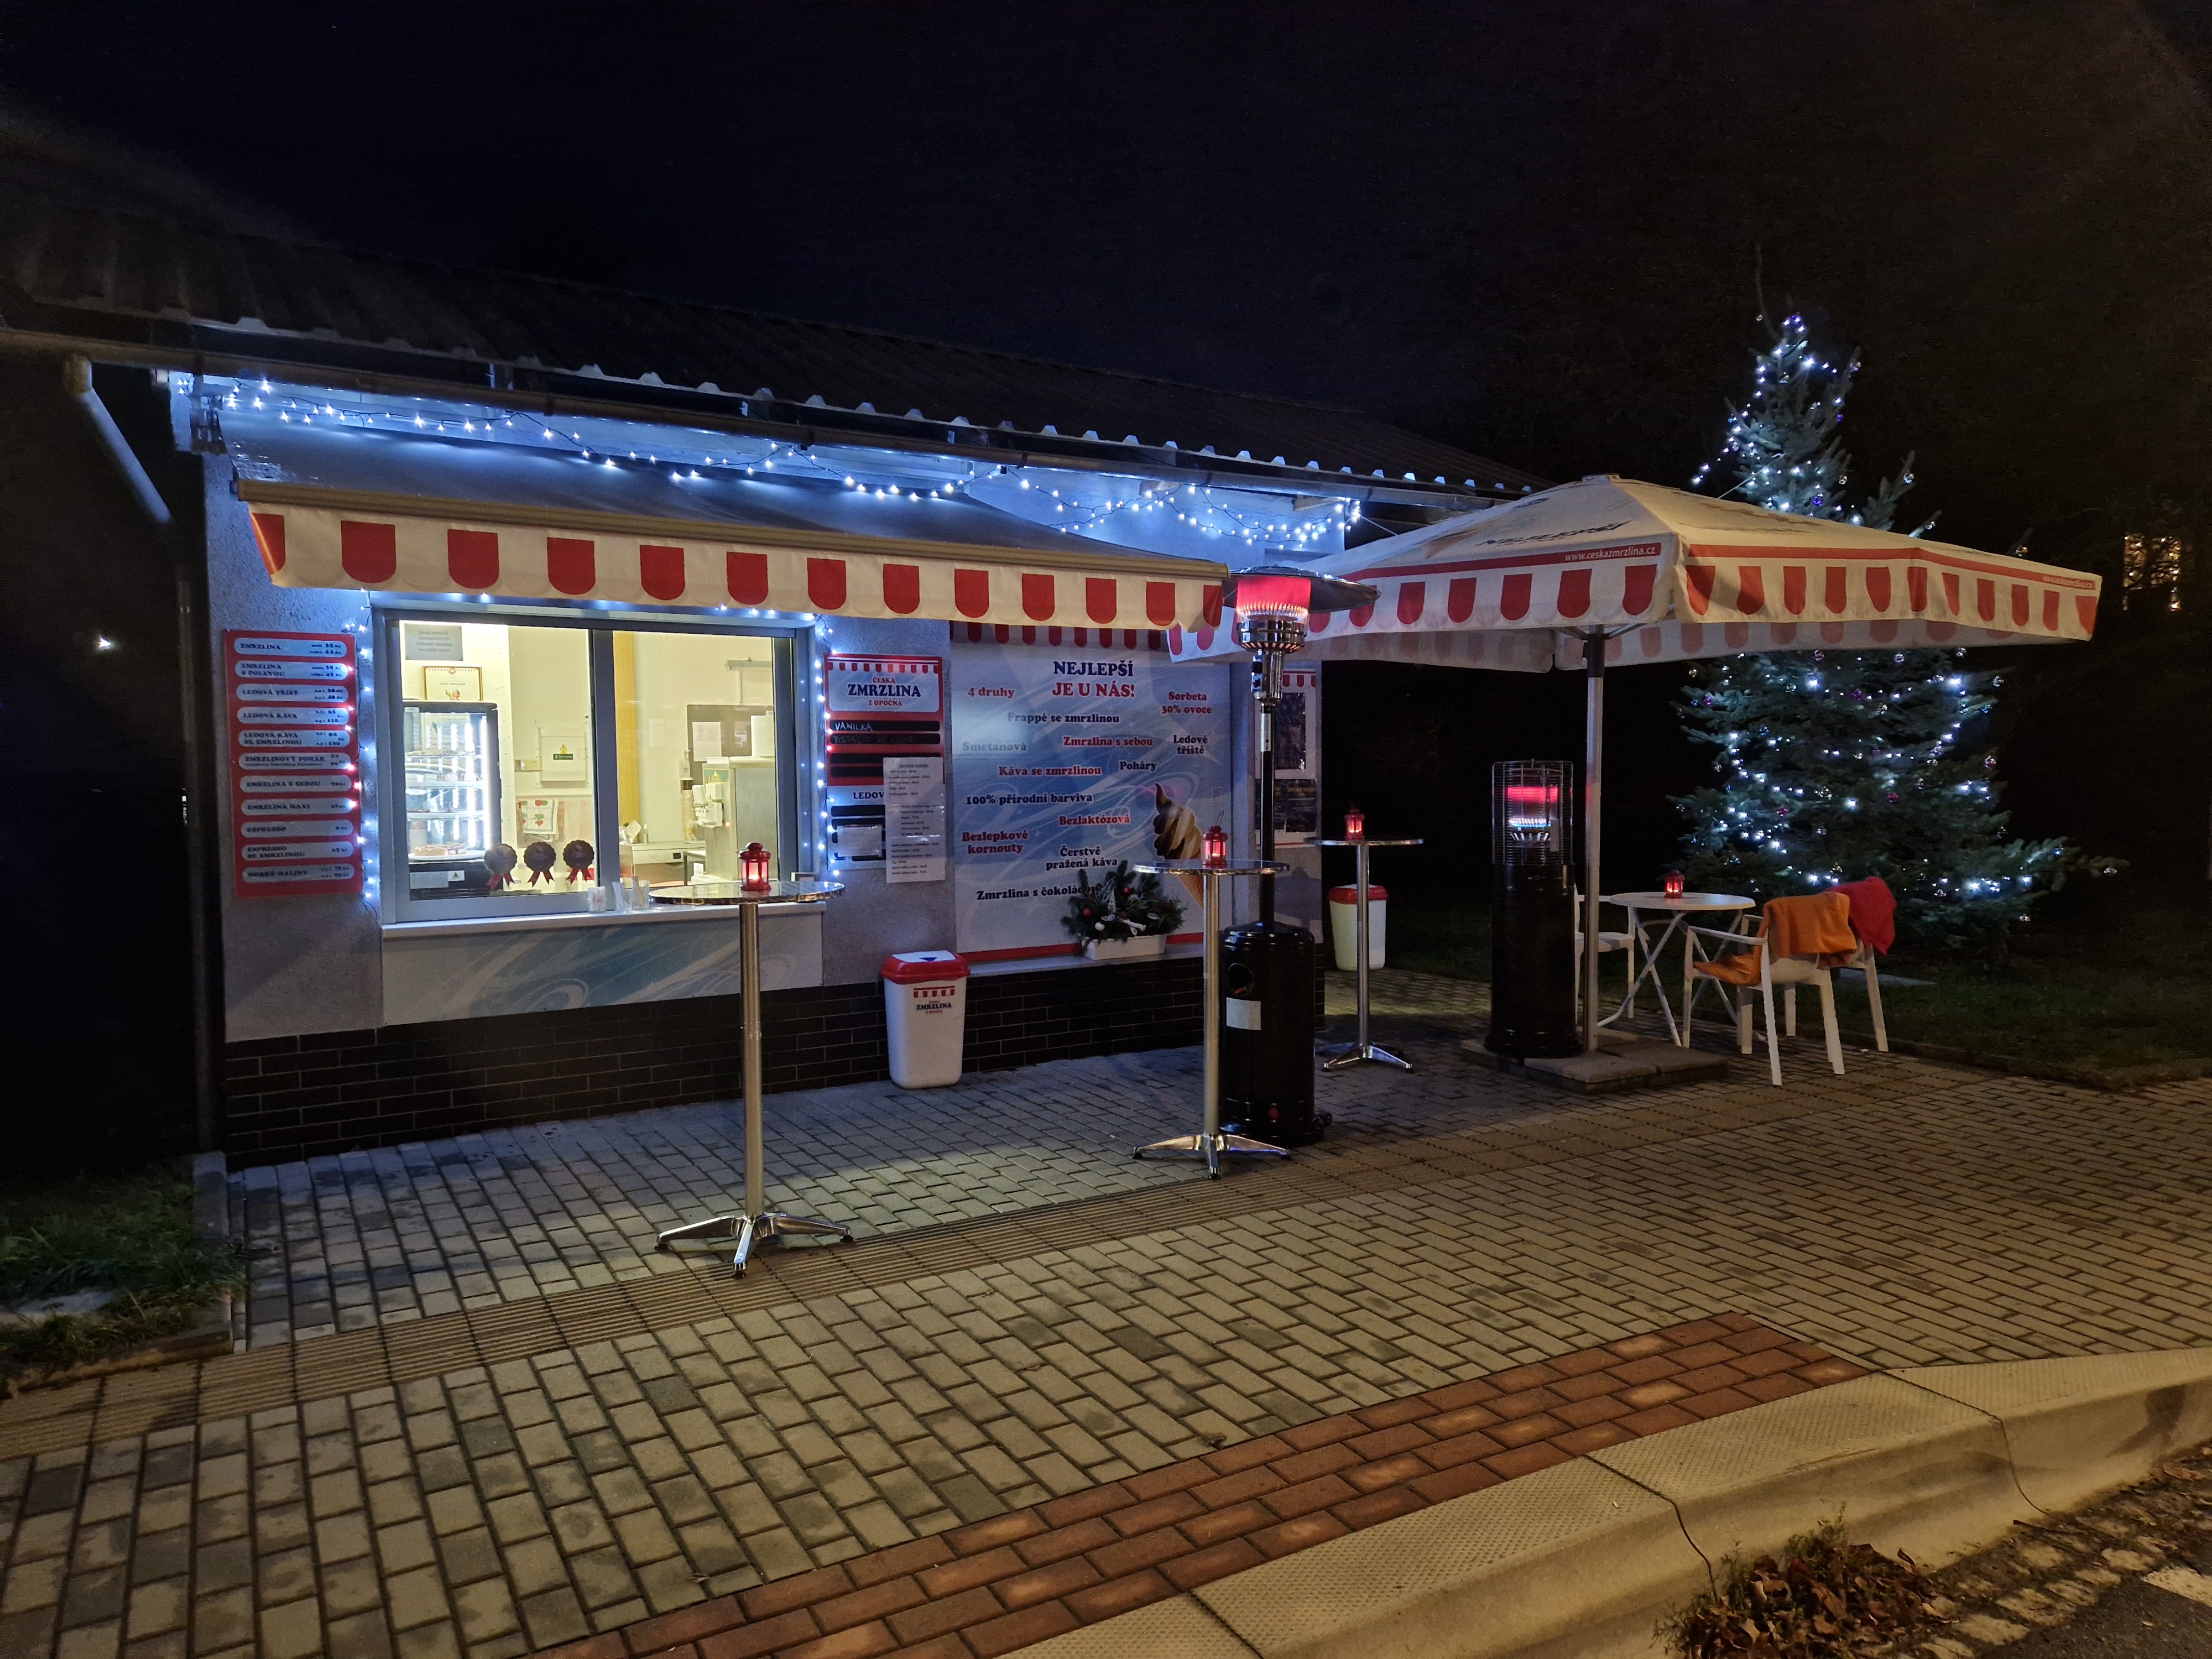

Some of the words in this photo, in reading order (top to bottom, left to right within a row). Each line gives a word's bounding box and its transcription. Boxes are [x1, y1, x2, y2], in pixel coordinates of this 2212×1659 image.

[1564, 546, 1656, 561] www.ceskazmrzlina.cz
[1053, 660, 1134, 677] NEJLEPŠÍ
[872, 675, 896, 684] ČESKÁ
[847, 684, 921, 697] ZMRZLINA
[968, 687, 975, 697] 4
[978, 687, 1015, 699] druhy
[1052, 682, 1074, 696] JE
[1078, 682, 1091, 697] U
[1095, 680, 1135, 697] NÁS!
[1168, 691, 1207, 701] Sorbeta
[1161, 705, 1181, 714] 30%
[1007, 712, 1047, 724] Frappé
[1050, 714, 1063, 723] se
[1065, 713, 1120, 723] zmrzlinou
[835, 722, 873, 732] VANILKA
[1063, 736, 1113, 746] Zmrzlina
[1124, 737, 1154, 746] sebou
[1173, 735, 1208, 744] Ledové
[962, 741, 1027, 752] Smetanová
[998, 766, 1027, 776] Káva
[1045, 765, 1102, 775] zmrzlinou
[1119, 760, 1157, 771] Poháry
[966, 795, 996, 805] 100%
[999, 793, 1047, 806] přírodní
[1051, 792, 1092, 802] barviva
[1058, 814, 1130, 826] Bezlaktózová
[962, 830, 1029, 842] Bezlepkové
[967, 843, 1024, 854] kornouty
[1060, 845, 1102, 857] Čerstvě
[1046, 858, 1089, 871] pražená
[1092, 857, 1118, 867] káva
[977, 889, 1030, 900] Zmrzlina
[916, 1002, 952, 1010] ZMRZLINA
